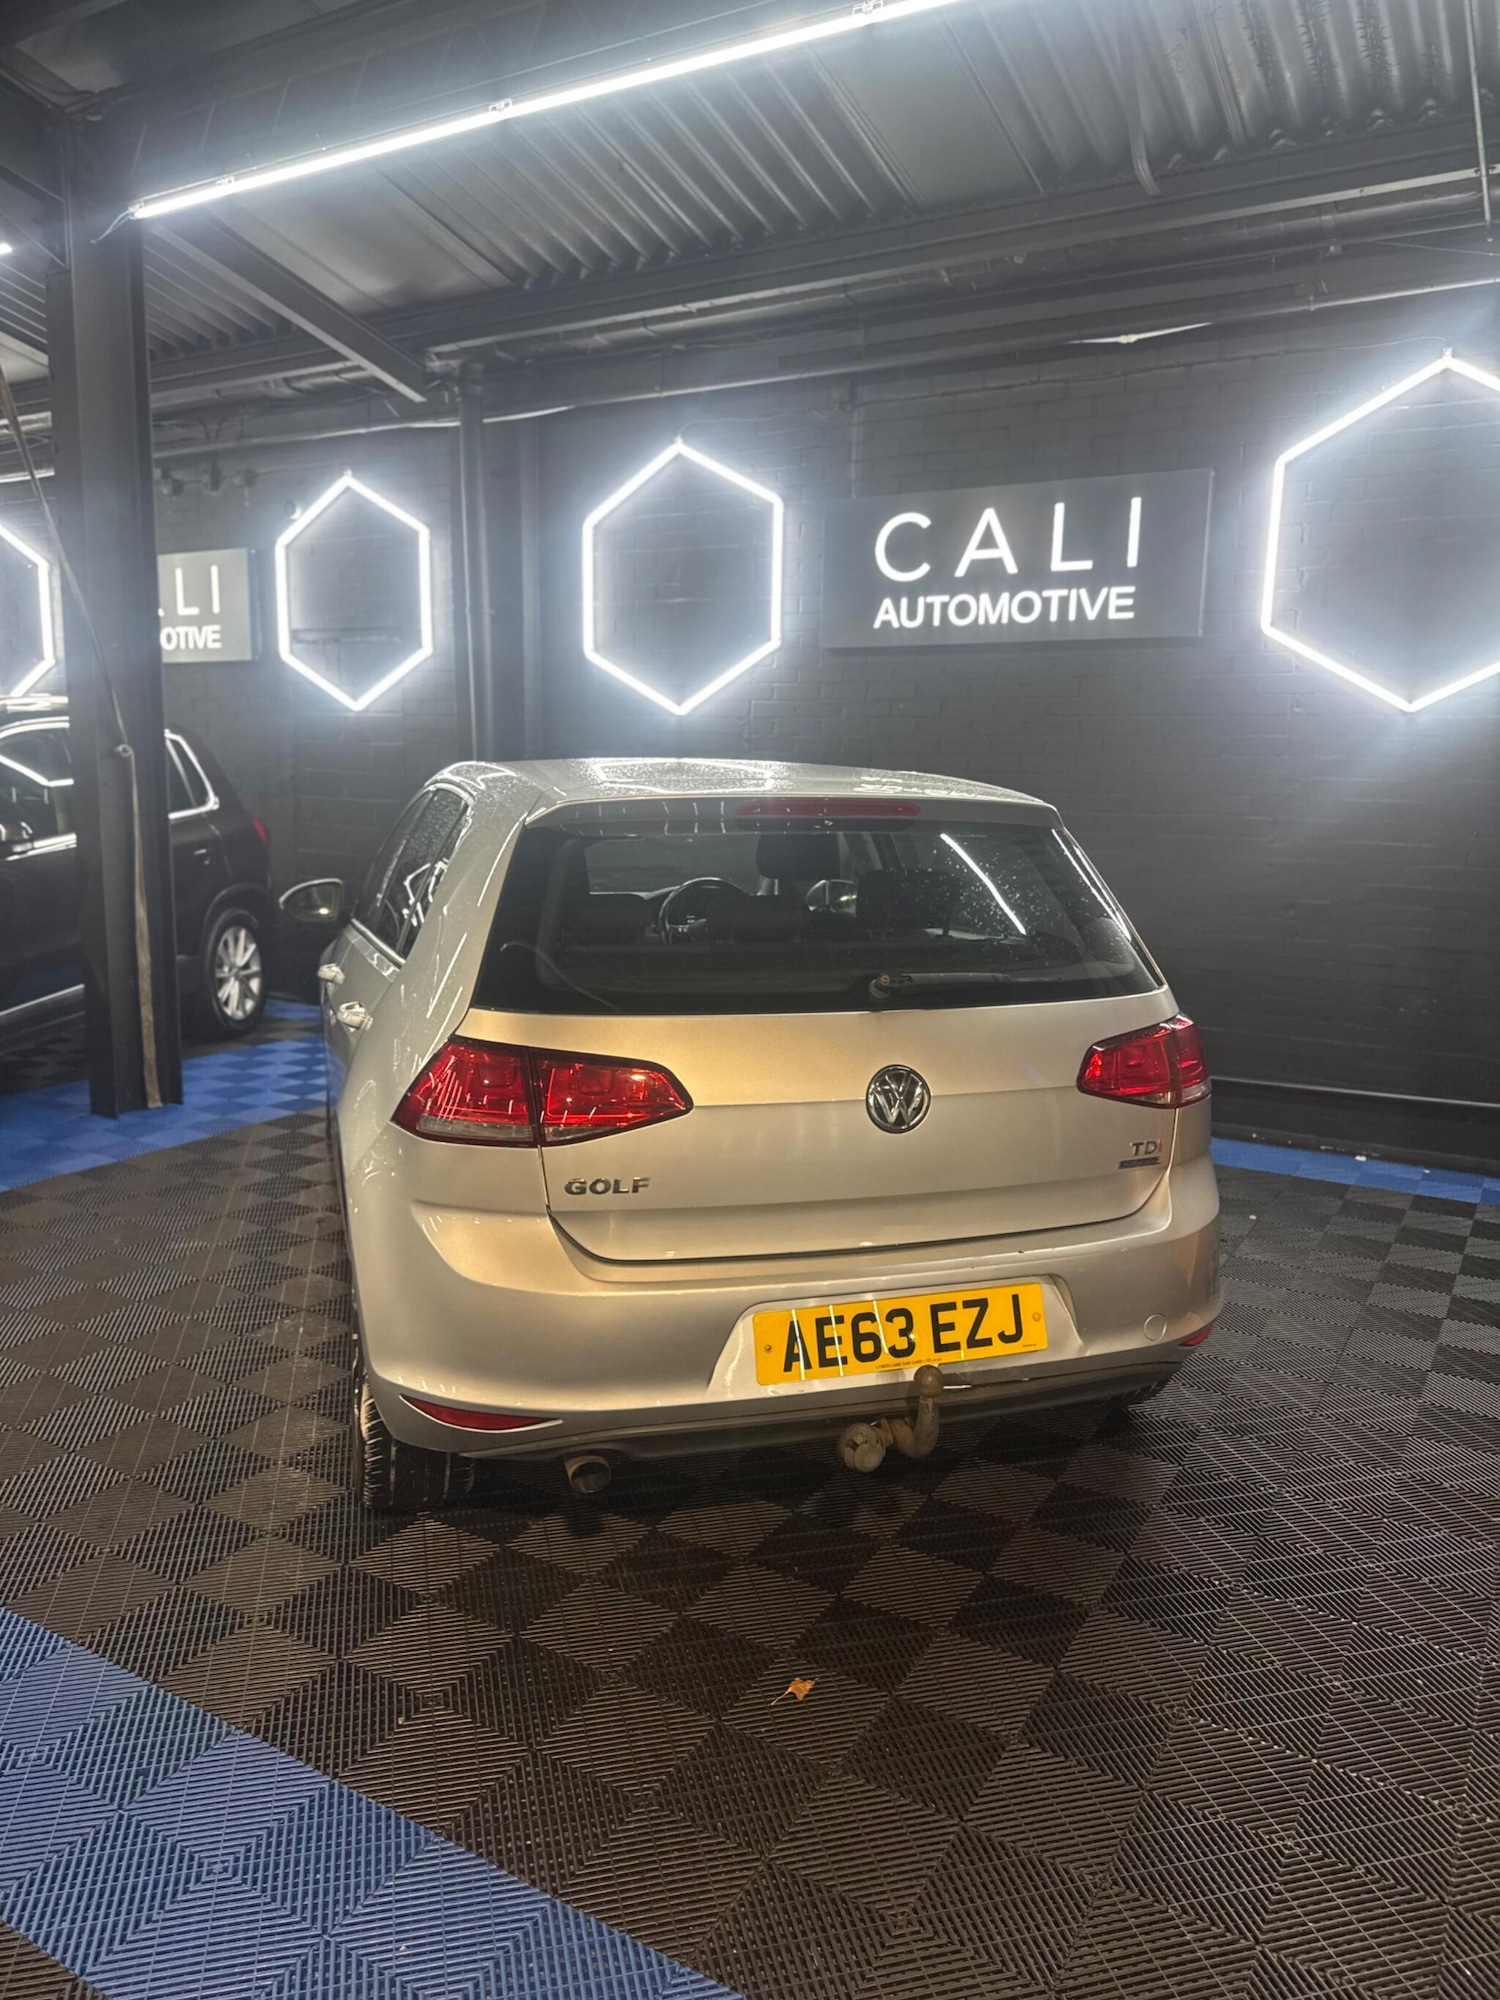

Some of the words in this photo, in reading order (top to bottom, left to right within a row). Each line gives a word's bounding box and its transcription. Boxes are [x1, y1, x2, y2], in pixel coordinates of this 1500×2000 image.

[874, 496, 1142, 583] CALI
[158, 564, 220, 617] LI
[873, 585, 1136, 629] AUTOMOTIVE
[564, 1176, 651, 1195] GOLF
[783, 1307, 917, 1373] AE63
[929, 1293, 1024, 1354] EZJ
